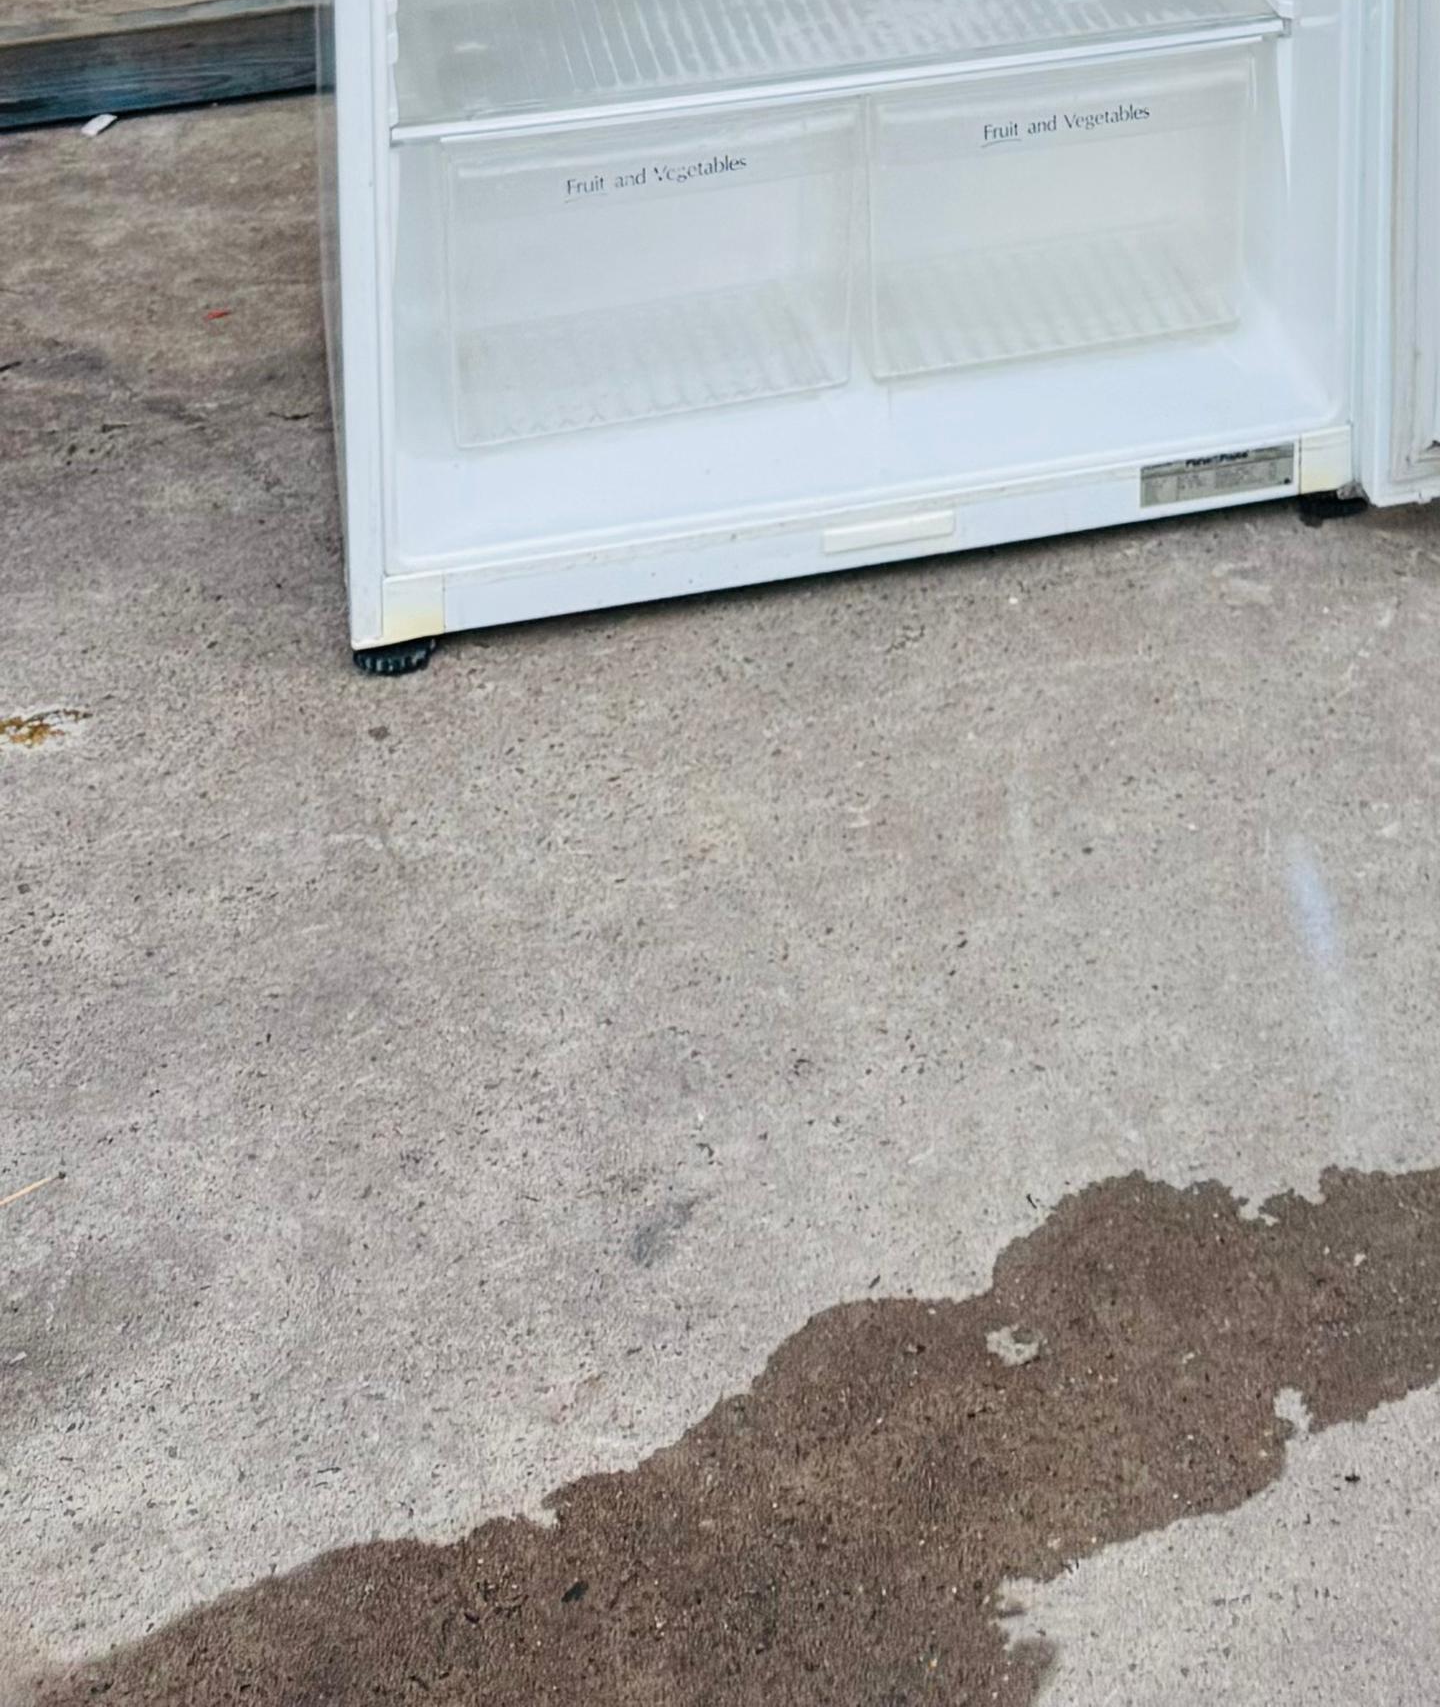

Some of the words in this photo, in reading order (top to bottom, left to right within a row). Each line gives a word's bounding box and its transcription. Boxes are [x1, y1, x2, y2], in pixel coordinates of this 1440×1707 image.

[984, 121, 1019, 141] Fruit
[1027, 115, 1057, 135] and
[1064, 104, 1150, 130] Vegetables
[566, 175, 604, 196] Fruit
[614, 167, 646, 188] and
[653, 154, 747, 183] Vegetables
